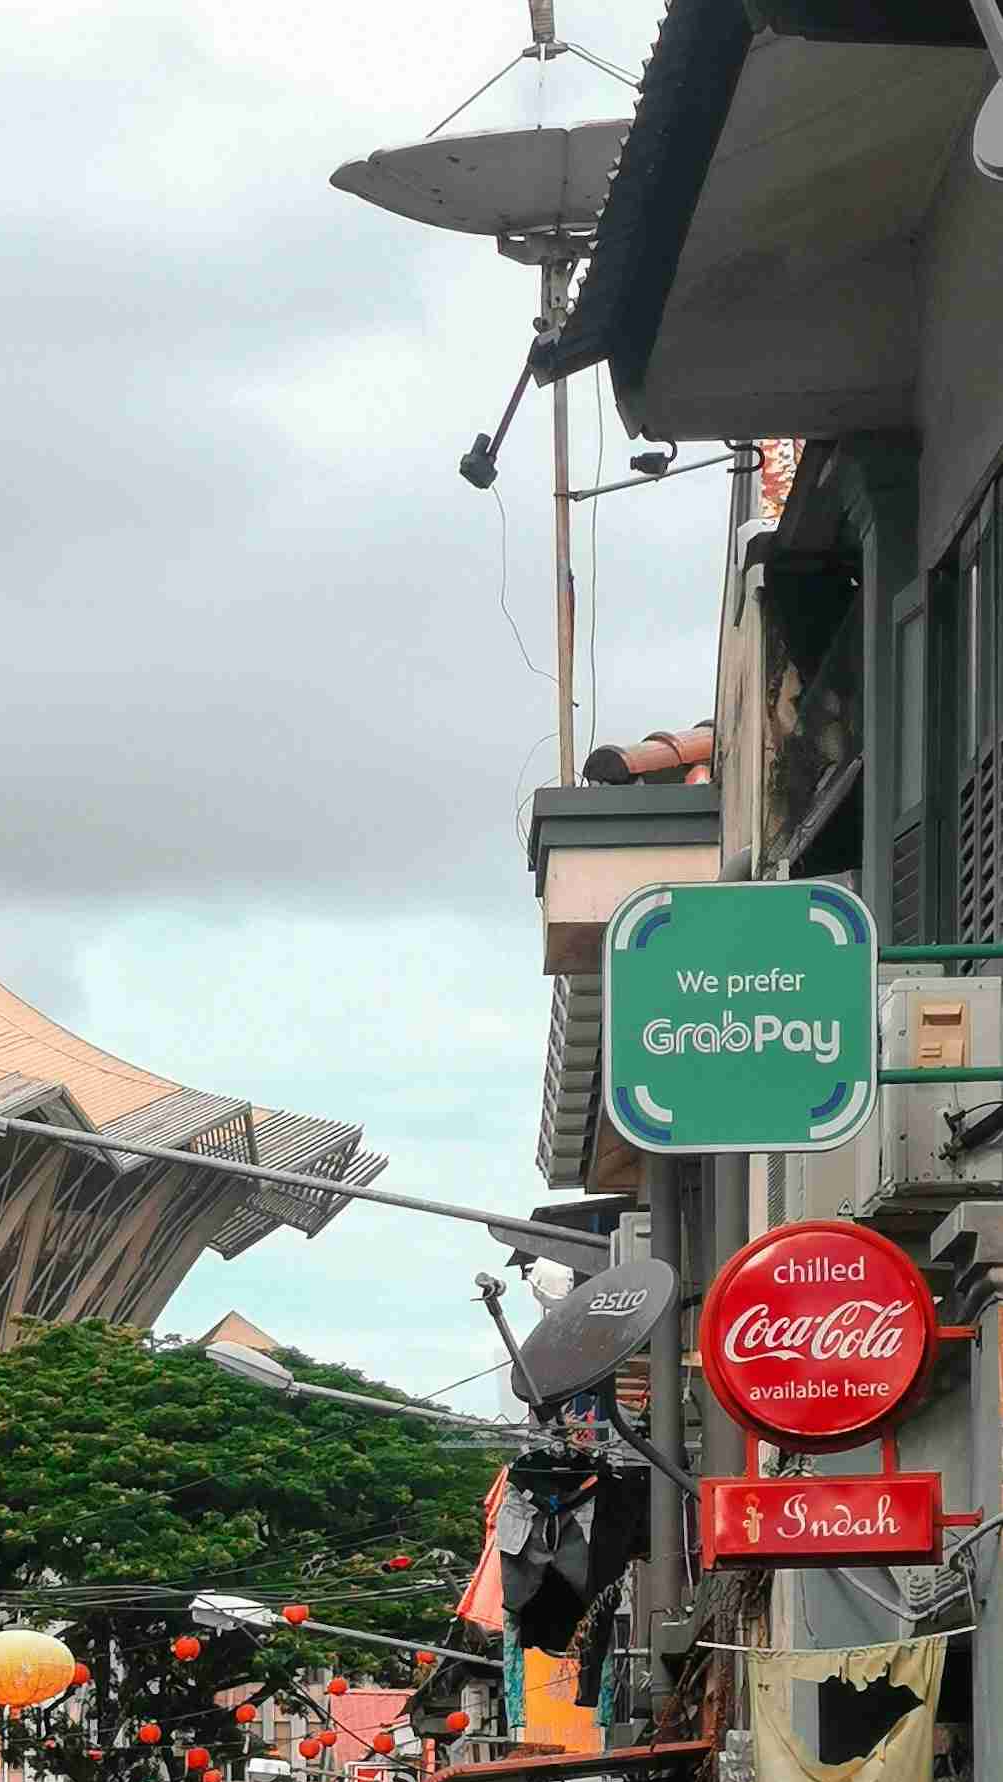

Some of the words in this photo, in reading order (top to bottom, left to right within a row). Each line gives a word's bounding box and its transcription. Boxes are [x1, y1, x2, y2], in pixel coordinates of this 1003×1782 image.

[677, 970, 719, 994] We
[727, 967, 806, 999] prefer
[642, 1009, 841, 1064] GrabPay
[773, 1255, 866, 1284] chilled
[589, 1289, 648, 1311] astro
[749, 1379, 839, 1401] available
[844, 1378, 890, 1398] here
[777, 1493, 901, 1539] Indah
